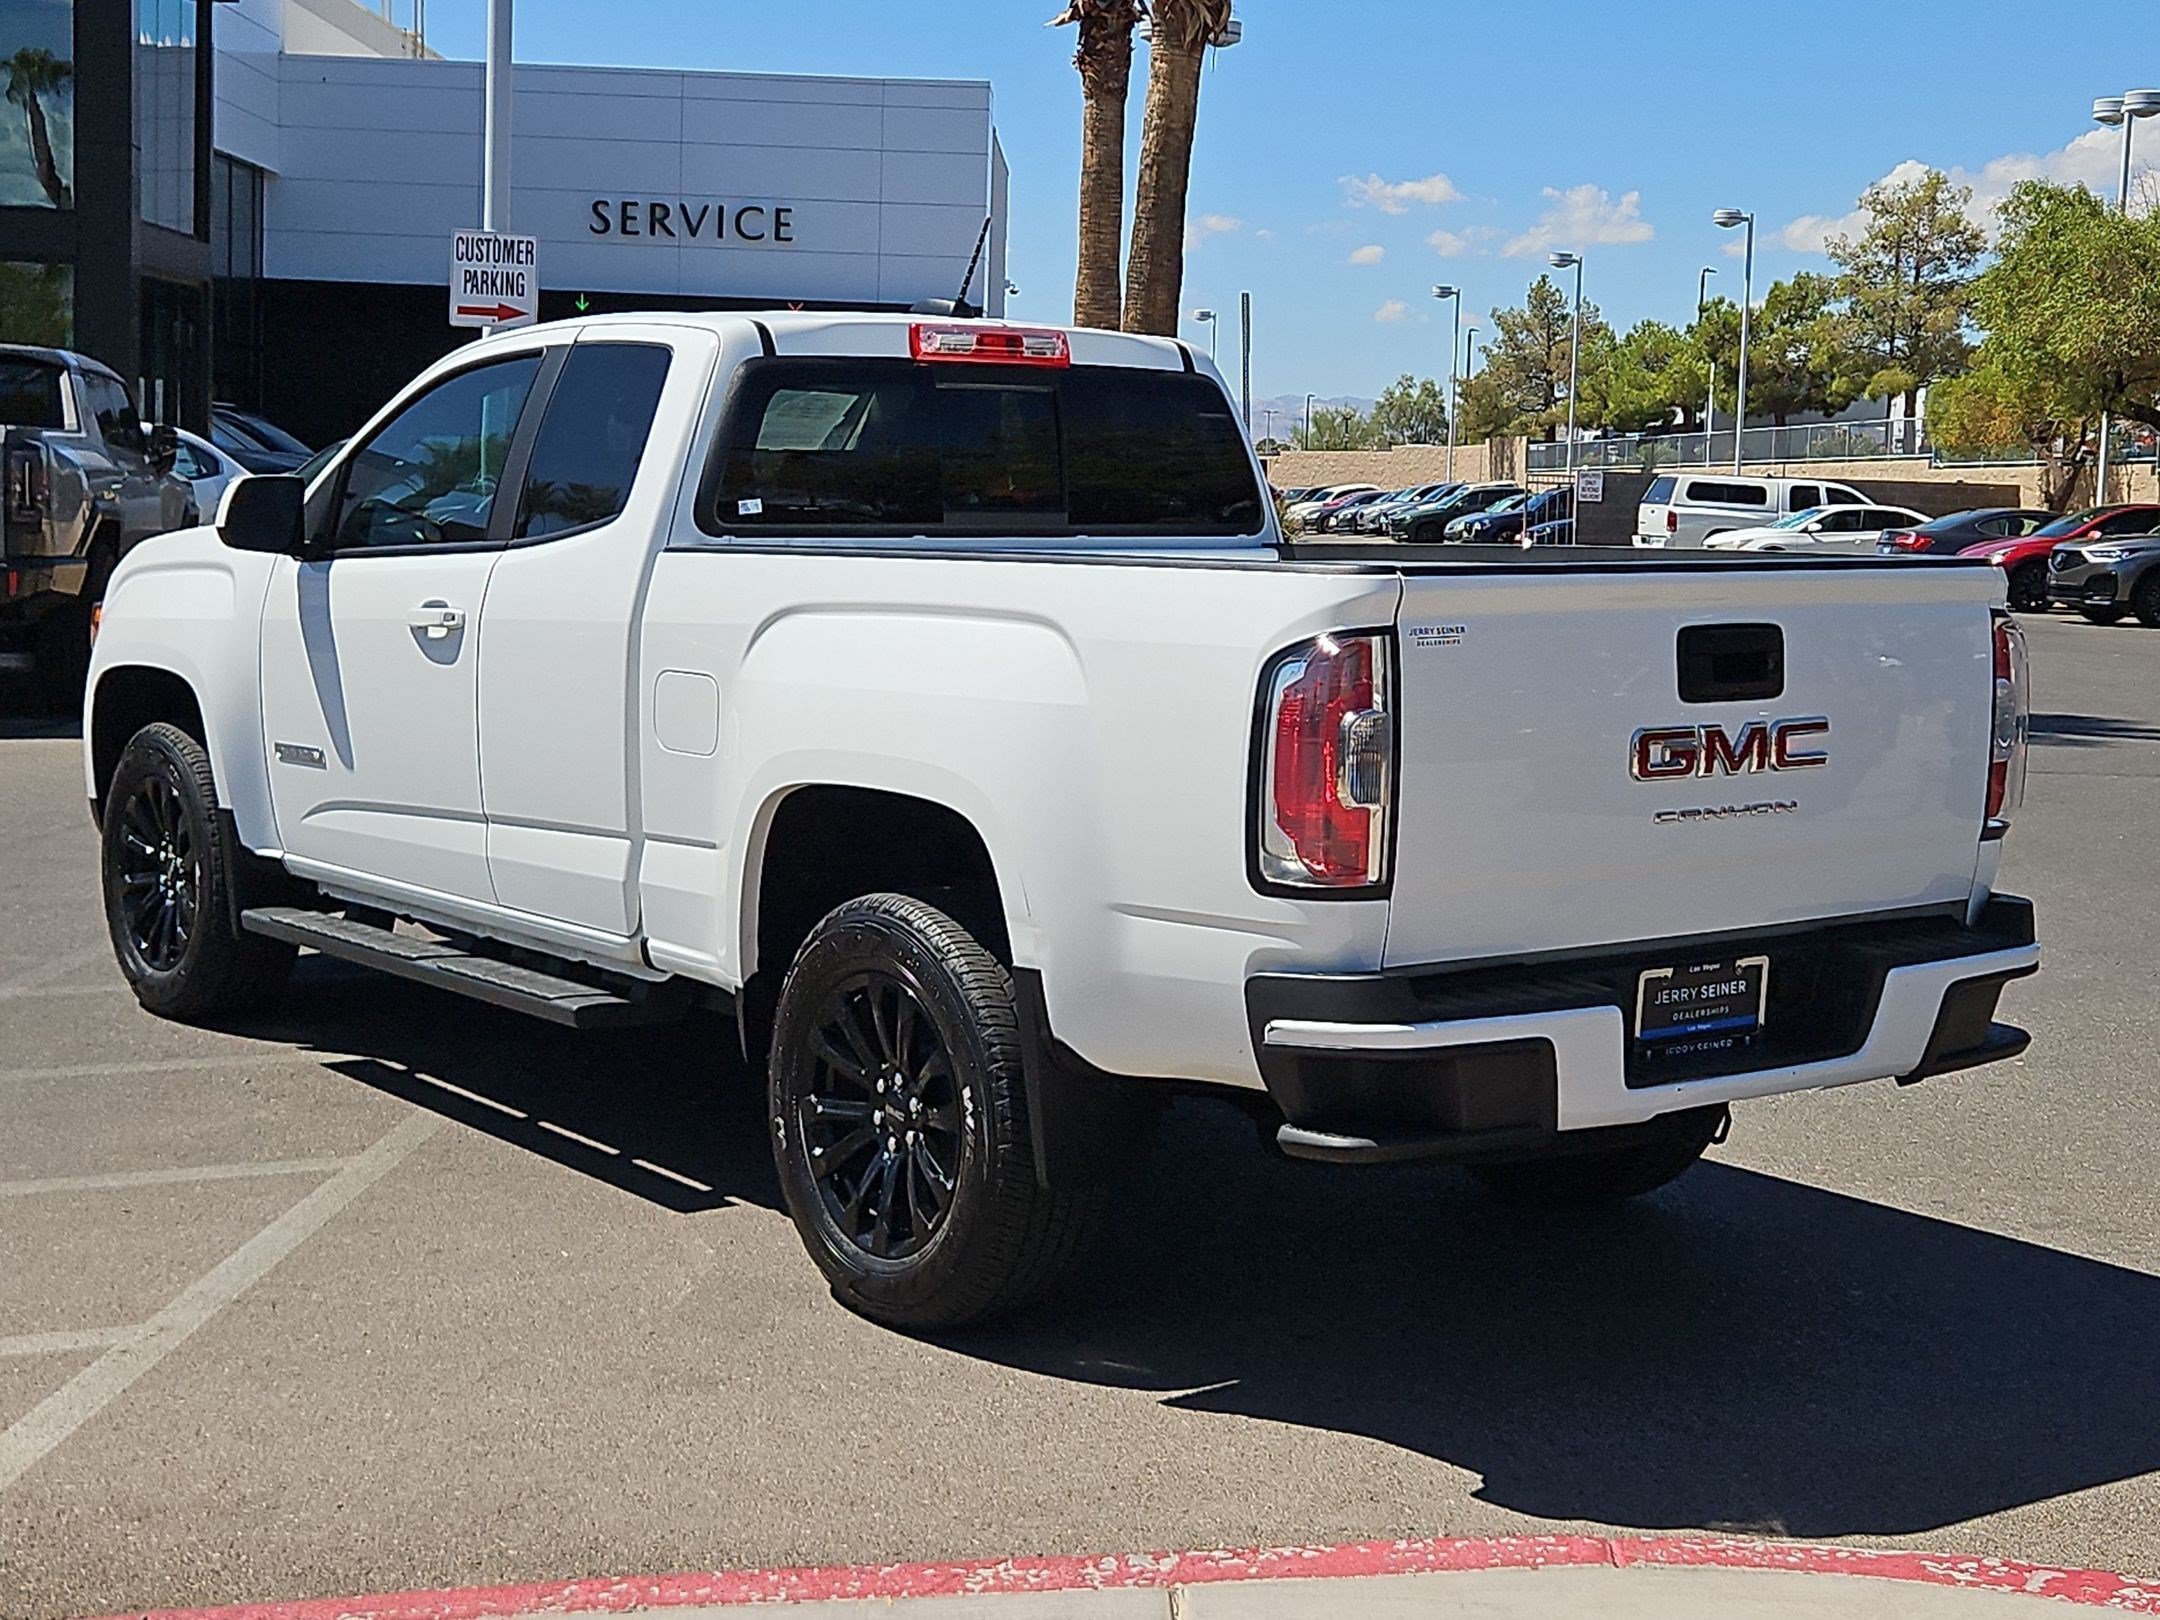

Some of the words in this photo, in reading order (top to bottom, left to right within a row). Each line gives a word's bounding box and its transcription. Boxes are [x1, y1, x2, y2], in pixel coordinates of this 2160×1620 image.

[588, 199, 794, 242] SERVICE
[455, 235, 535, 266] CUSTOMER
[463, 268, 526, 297] PARKING
[1408, 627, 1435, 637] JERRY
[1436, 626, 1466, 635] SEINER
[1630, 716, 1830, 782] GMC
[1653, 800, 1799, 825] CANYON
[1689, 965, 1701, 973] Las
[1702, 963, 1721, 971] Vegas
[1654, 987, 1698, 1004] JERRY
[1700, 980, 1747, 999] SEINER
[1672, 1006, 1729, 1021] DEALERSHIPS
